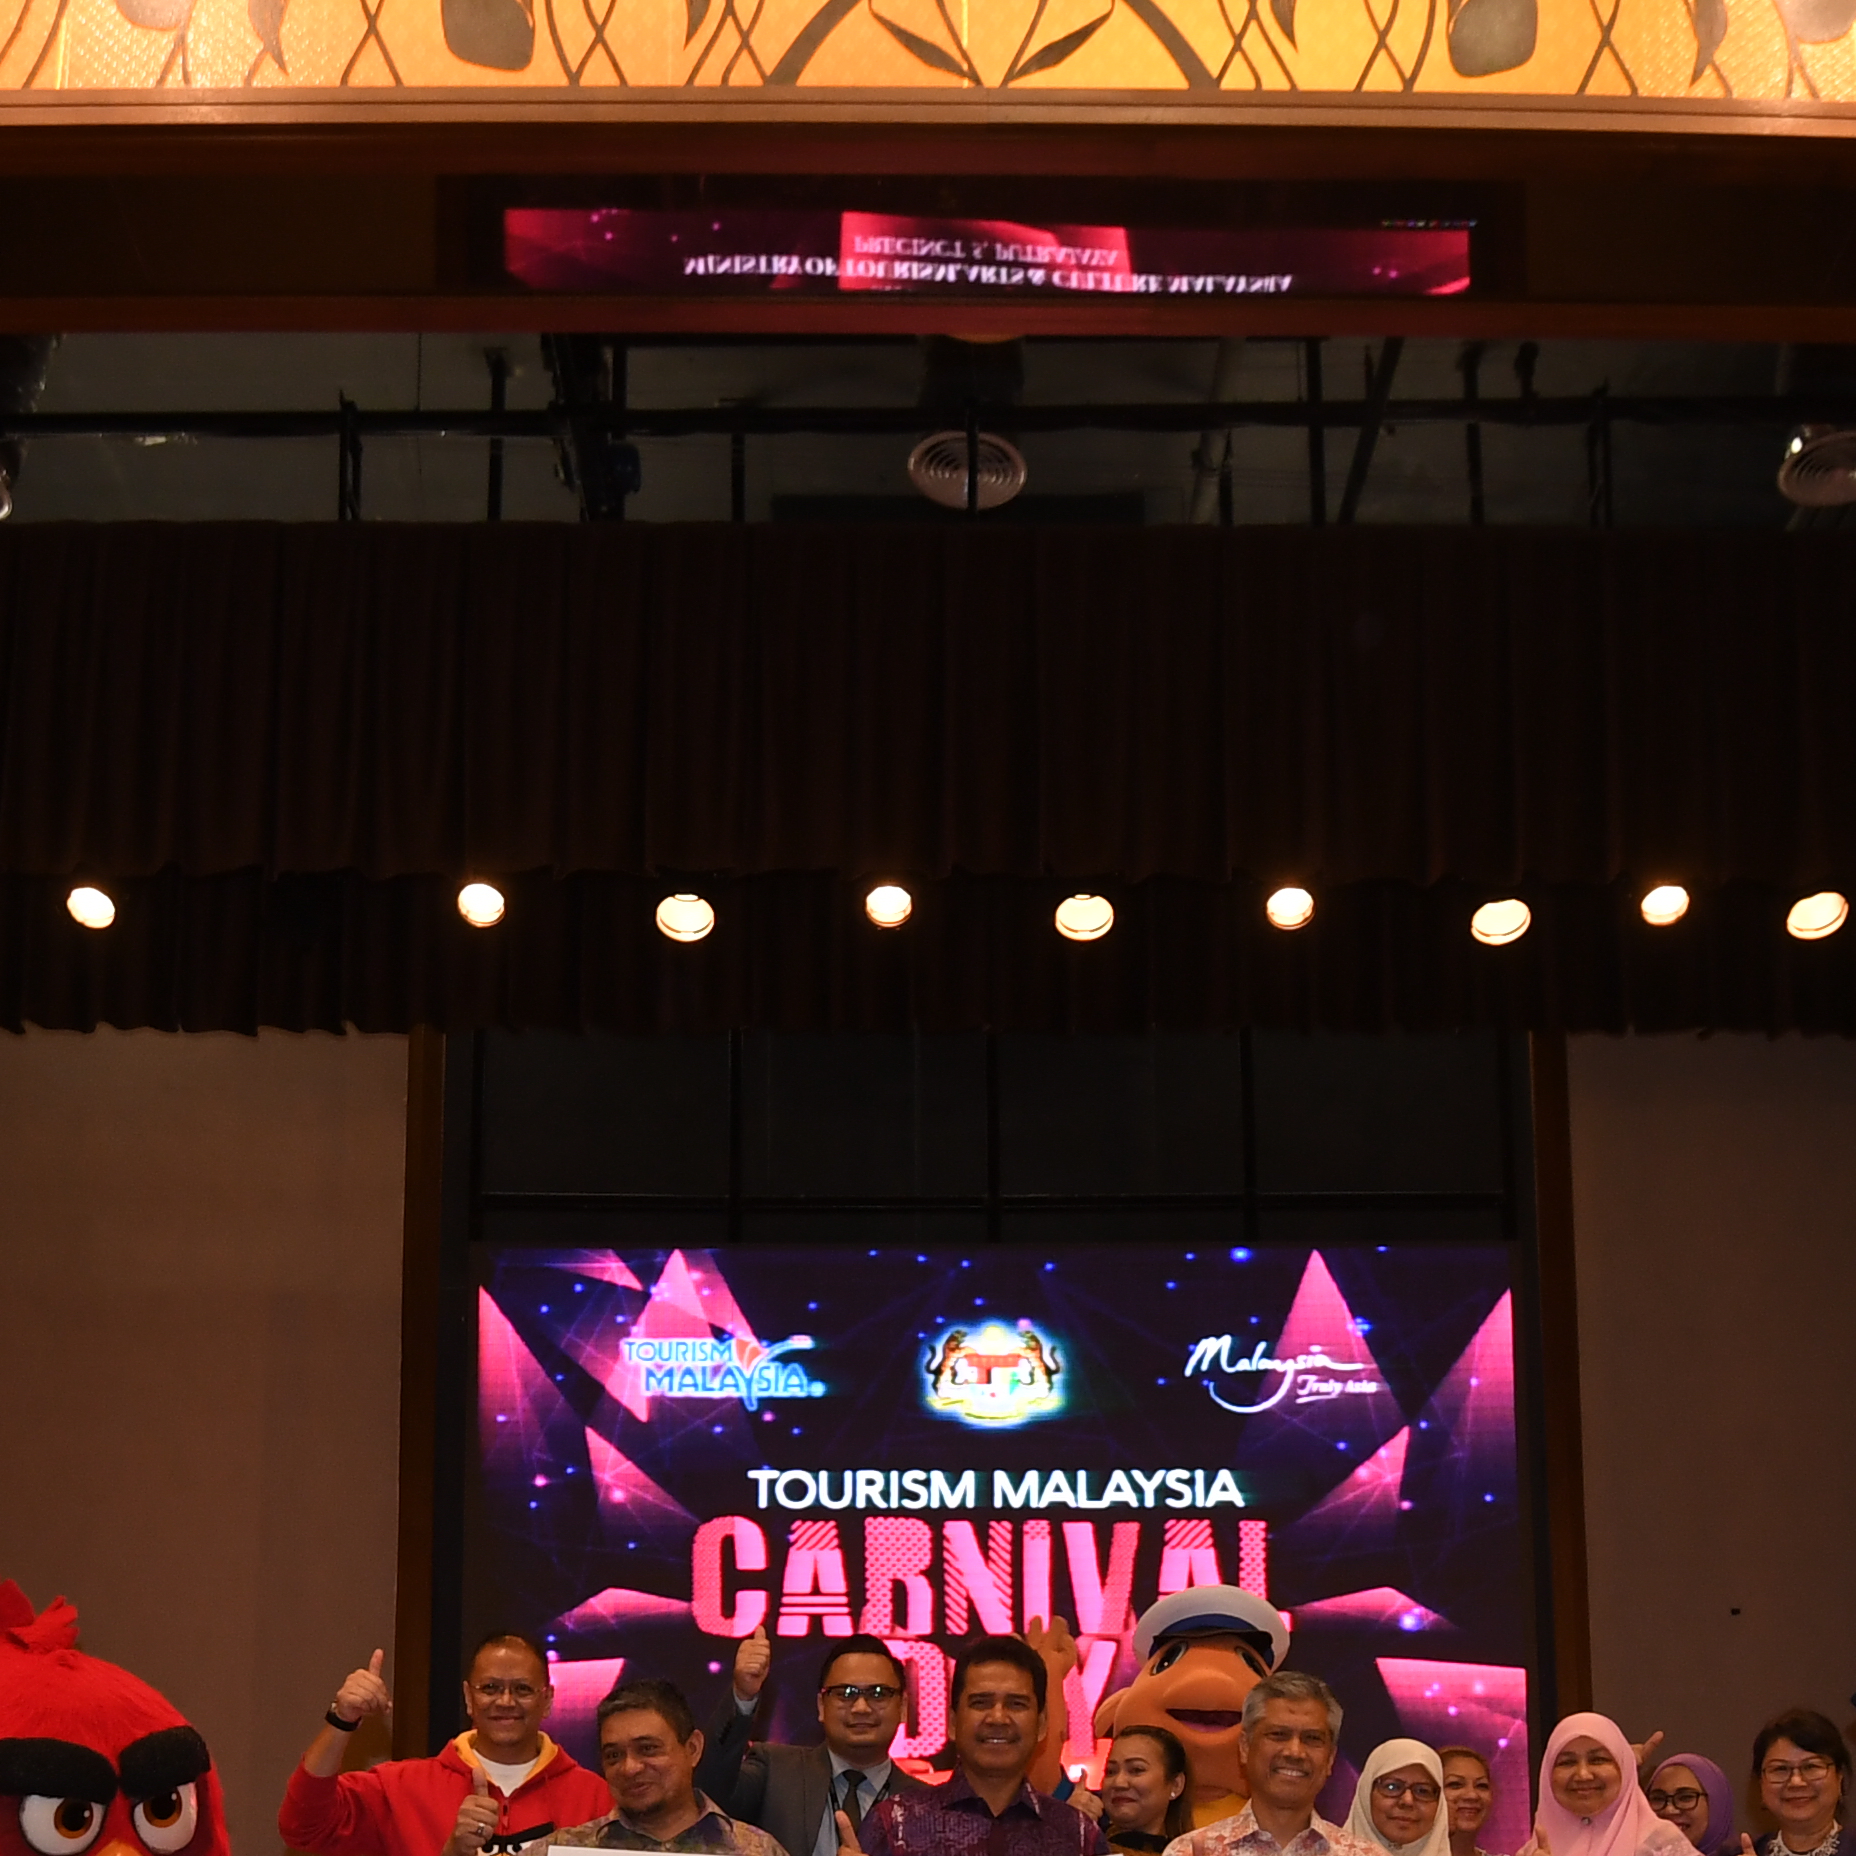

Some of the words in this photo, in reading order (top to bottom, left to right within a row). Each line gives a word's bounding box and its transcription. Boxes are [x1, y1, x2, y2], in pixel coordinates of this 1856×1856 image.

[624, 1341, 733, 1363] TOURISM
[645, 1367, 809, 1410] MALAYSIA
[747, 1469, 976, 1509] TOURISM
[993, 1469, 1245, 1509] MALAYSIA
[879, 1637, 1119, 1760] DY
